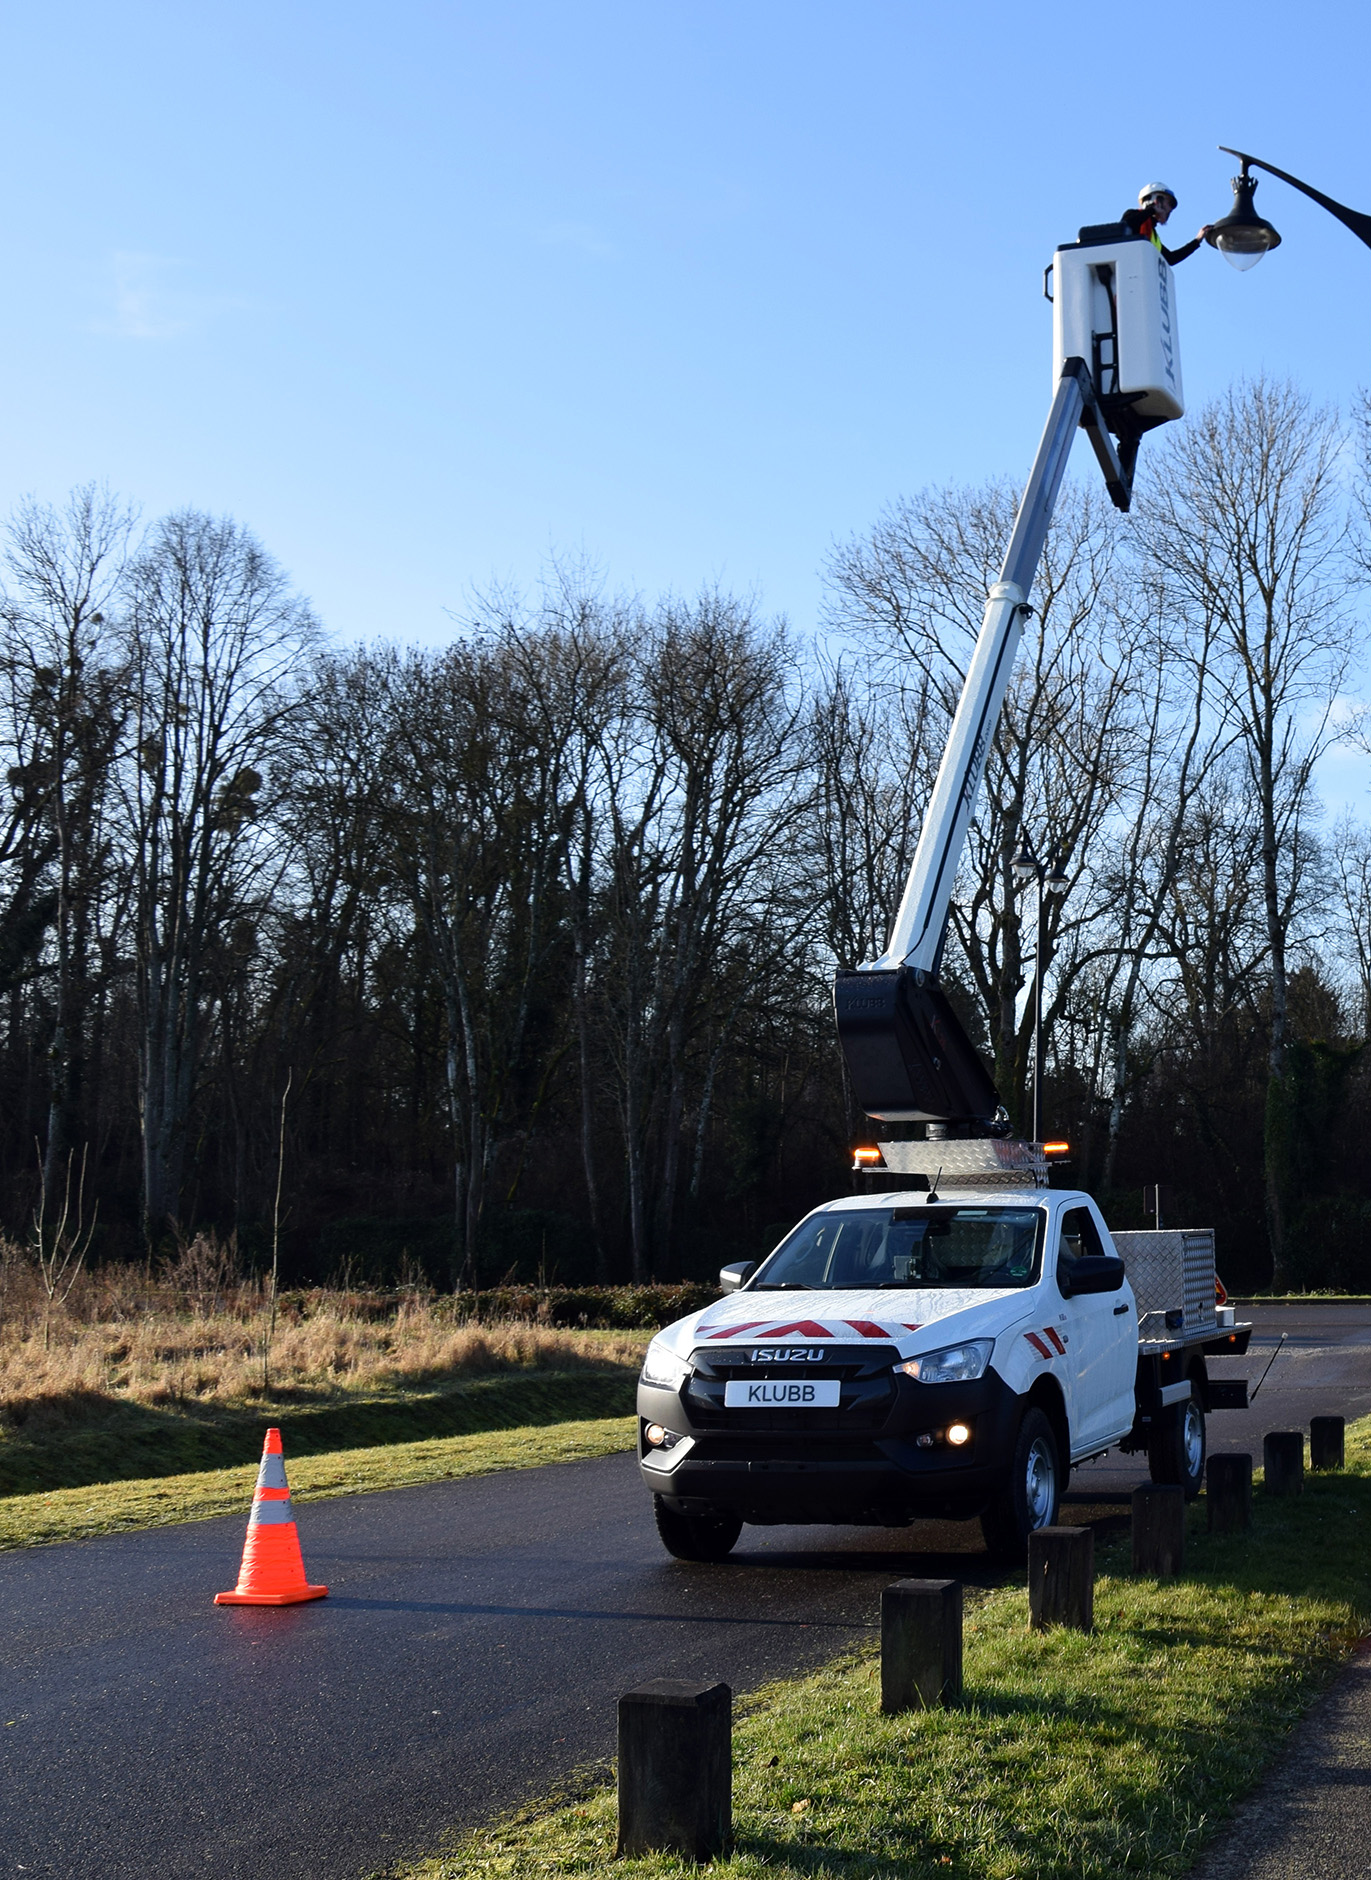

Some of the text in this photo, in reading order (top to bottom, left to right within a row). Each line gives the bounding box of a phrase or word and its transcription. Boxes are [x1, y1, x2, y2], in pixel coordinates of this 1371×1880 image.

[1158, 256, 1177, 394] KLUBB
[750, 1348, 825, 1362] ISUZU
[748, 1384, 816, 1403] KLUBB
